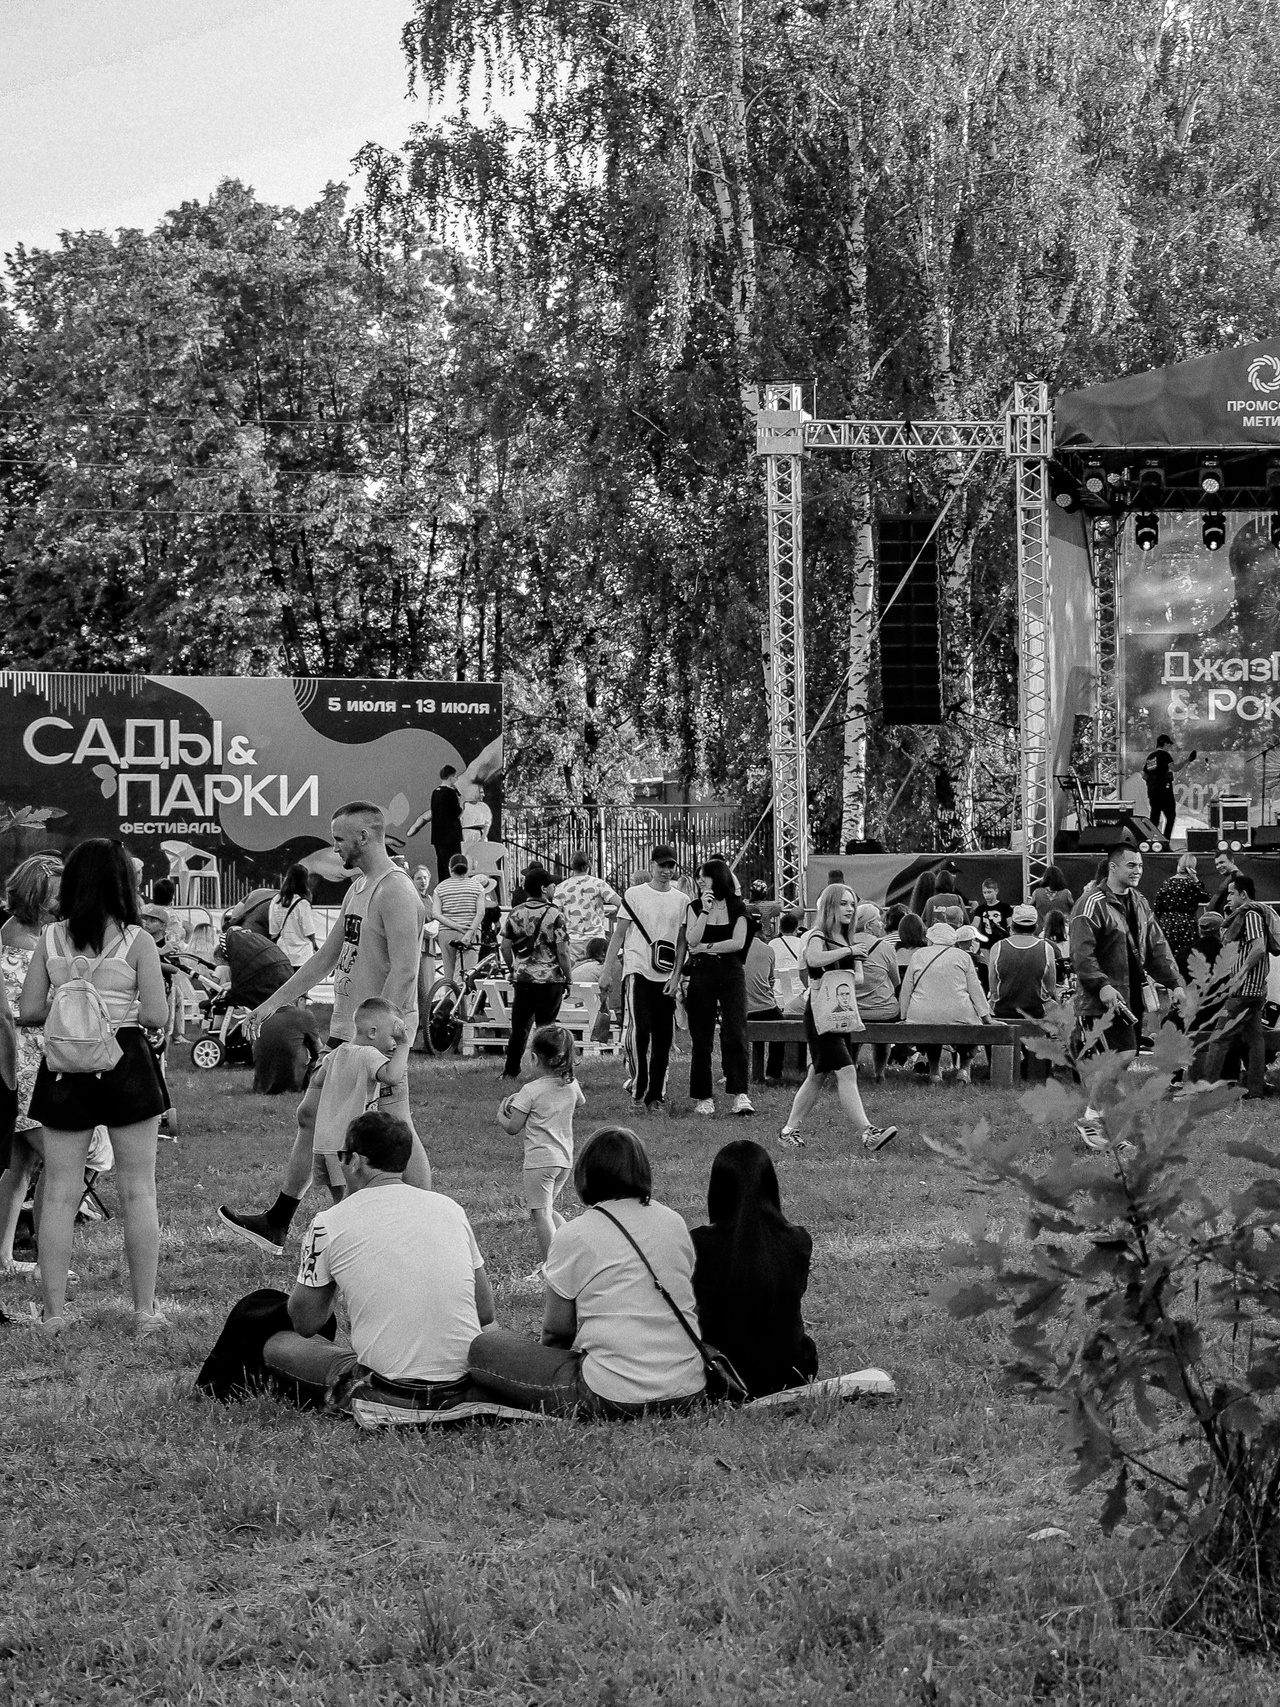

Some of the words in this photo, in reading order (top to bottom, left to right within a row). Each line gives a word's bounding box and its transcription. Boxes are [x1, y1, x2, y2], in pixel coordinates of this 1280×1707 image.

[328, 697, 341, 711] 5
[415, 699, 436, 713] 13
[1168, 689, 1200, 720] &
[118, 773, 319, 817] ПАРКИ
[119, 821, 222, 834] ФЕСТИВАЛЬ
